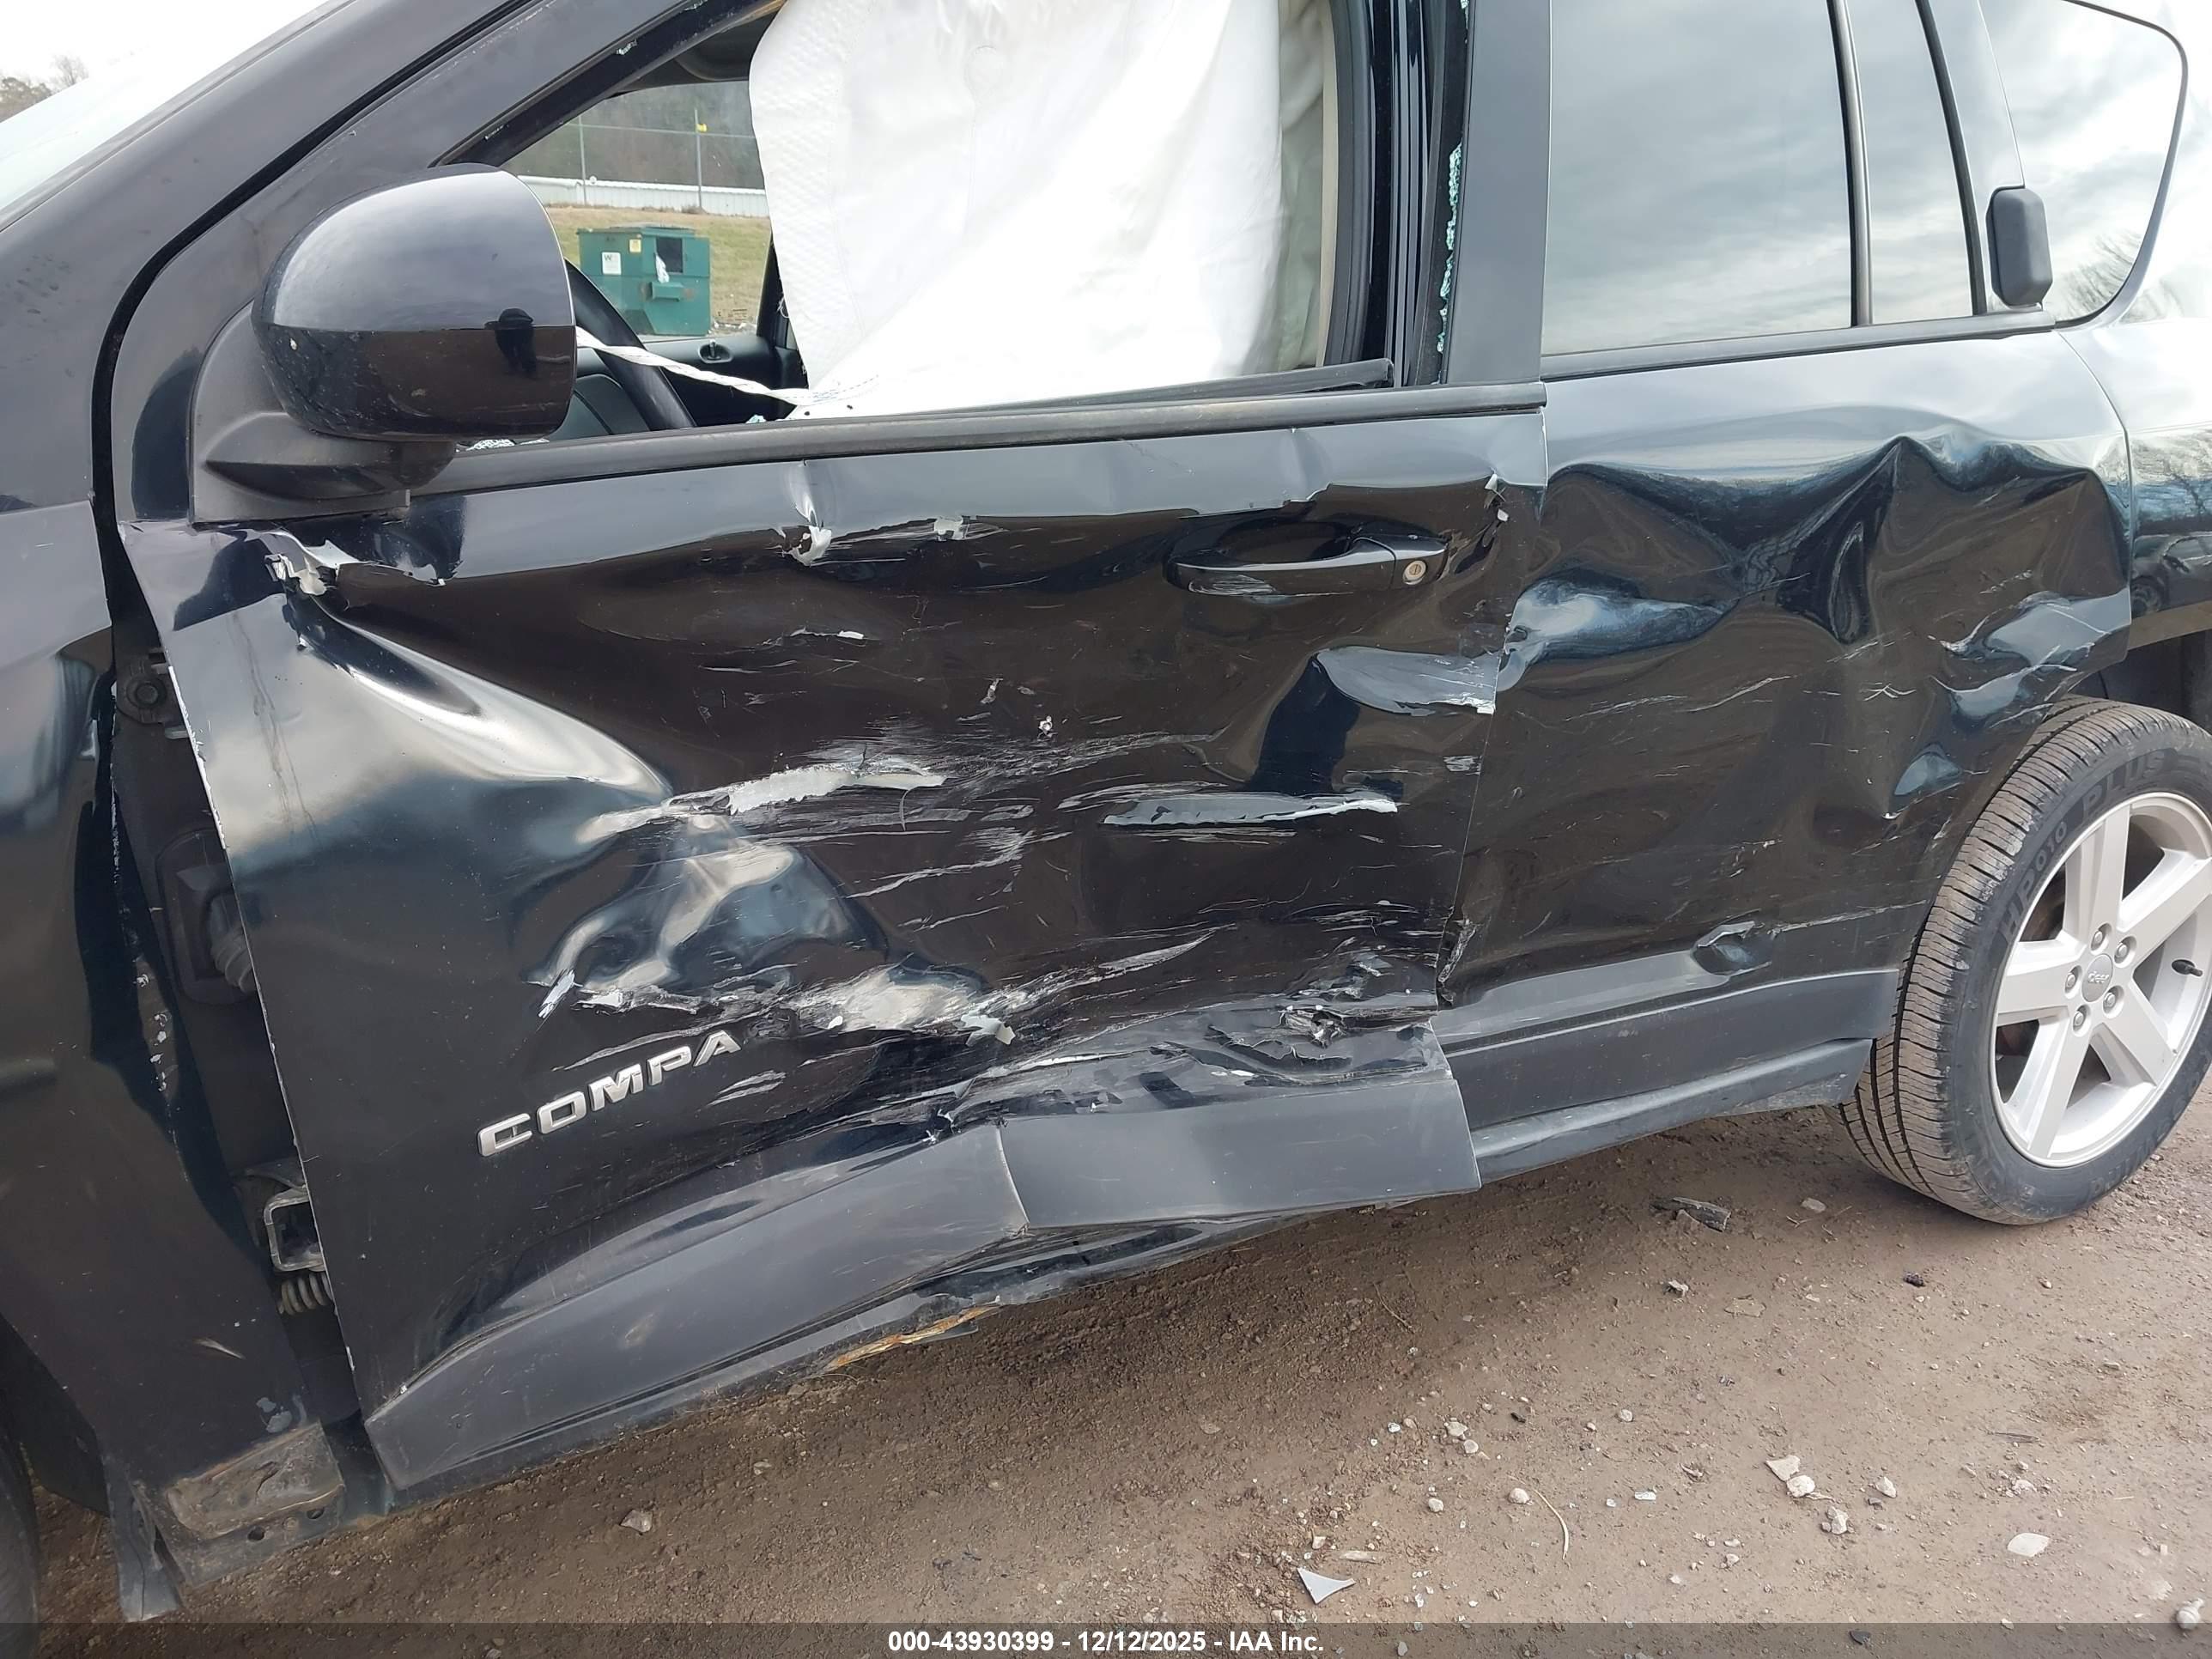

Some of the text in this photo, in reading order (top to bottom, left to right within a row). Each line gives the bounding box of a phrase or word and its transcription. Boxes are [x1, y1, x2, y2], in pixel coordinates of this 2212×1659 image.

[2002, 749, 2165, 939] HP010 PLUS
[477, 1030, 742, 1157] COMPA
